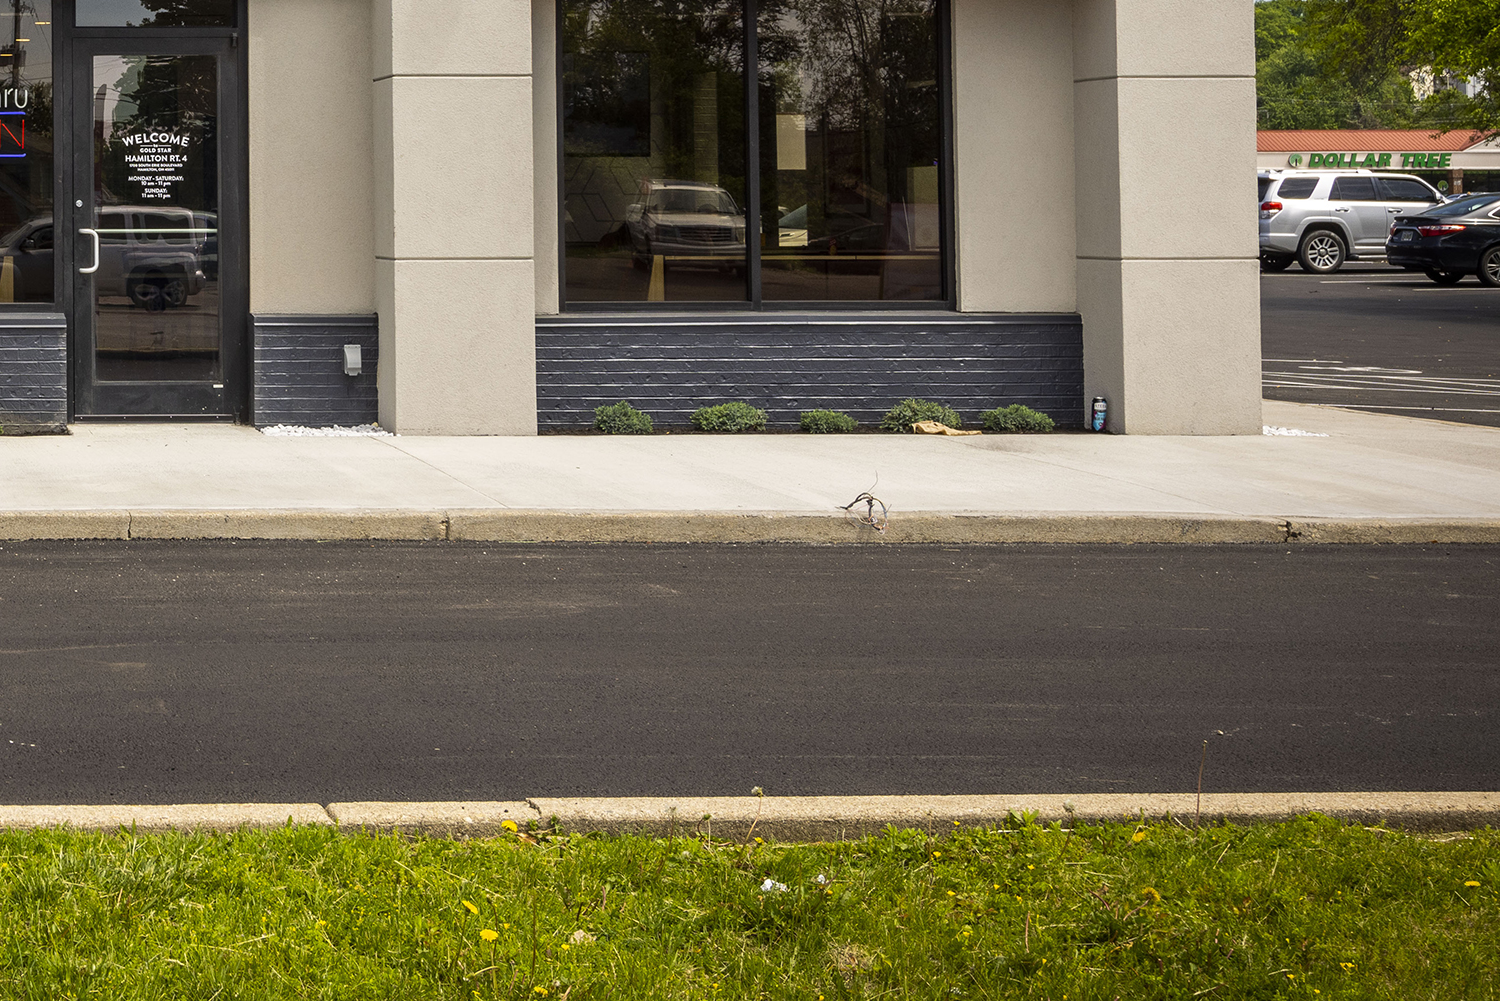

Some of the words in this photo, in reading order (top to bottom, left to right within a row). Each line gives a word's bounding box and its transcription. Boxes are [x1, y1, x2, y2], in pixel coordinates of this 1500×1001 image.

[121, 132, 190, 147] WELCOME
[124, 154, 168, 162] HAMILTON
[169, 154, 181, 162] RT.
[181, 154, 188, 162] 4
[1309, 153, 1392, 168] DOLLAR
[1401, 153, 1453, 168] TREE
